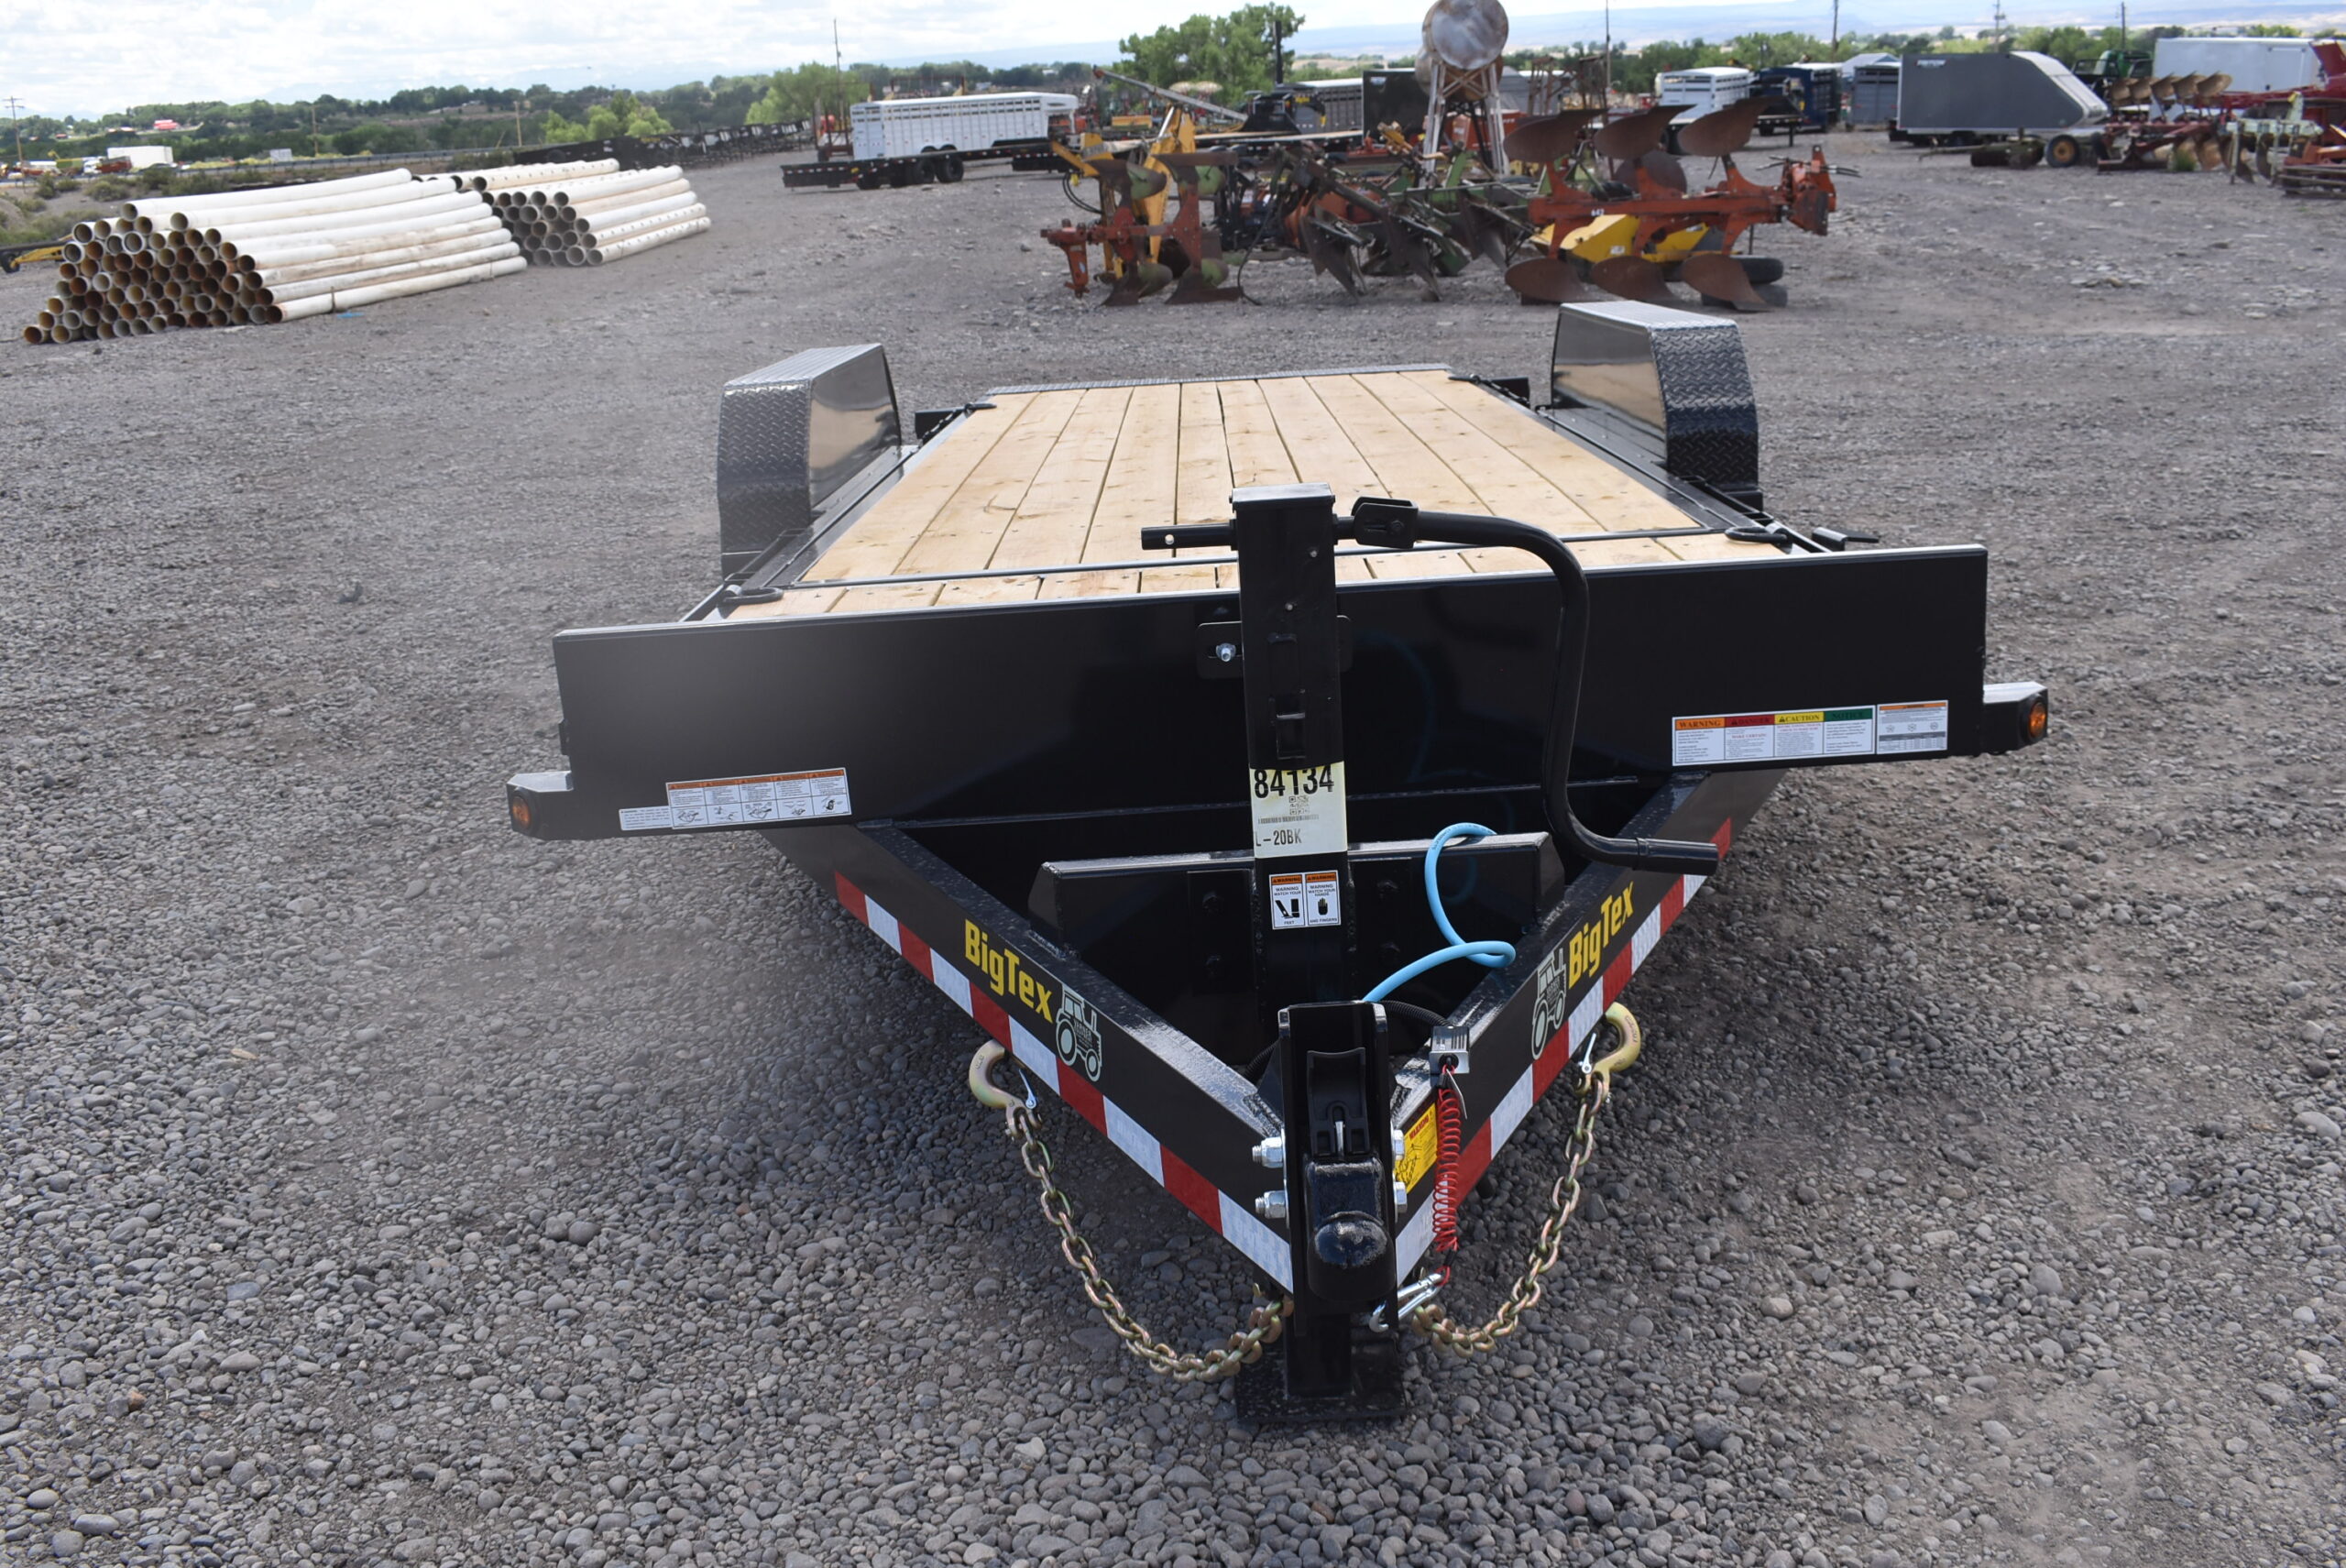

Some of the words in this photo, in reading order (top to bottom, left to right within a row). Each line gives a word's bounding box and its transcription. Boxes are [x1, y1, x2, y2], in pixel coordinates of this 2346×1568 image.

[1679, 720, 1721, 729] WARNING
[1738, 717, 1770, 725] DANGER
[1785, 714, 1820, 722] CAUTION
[1254, 765, 1334, 798] 84134
[1568, 881, 1634, 990] BigTex
[965, 918, 1053, 1024] BigTex
